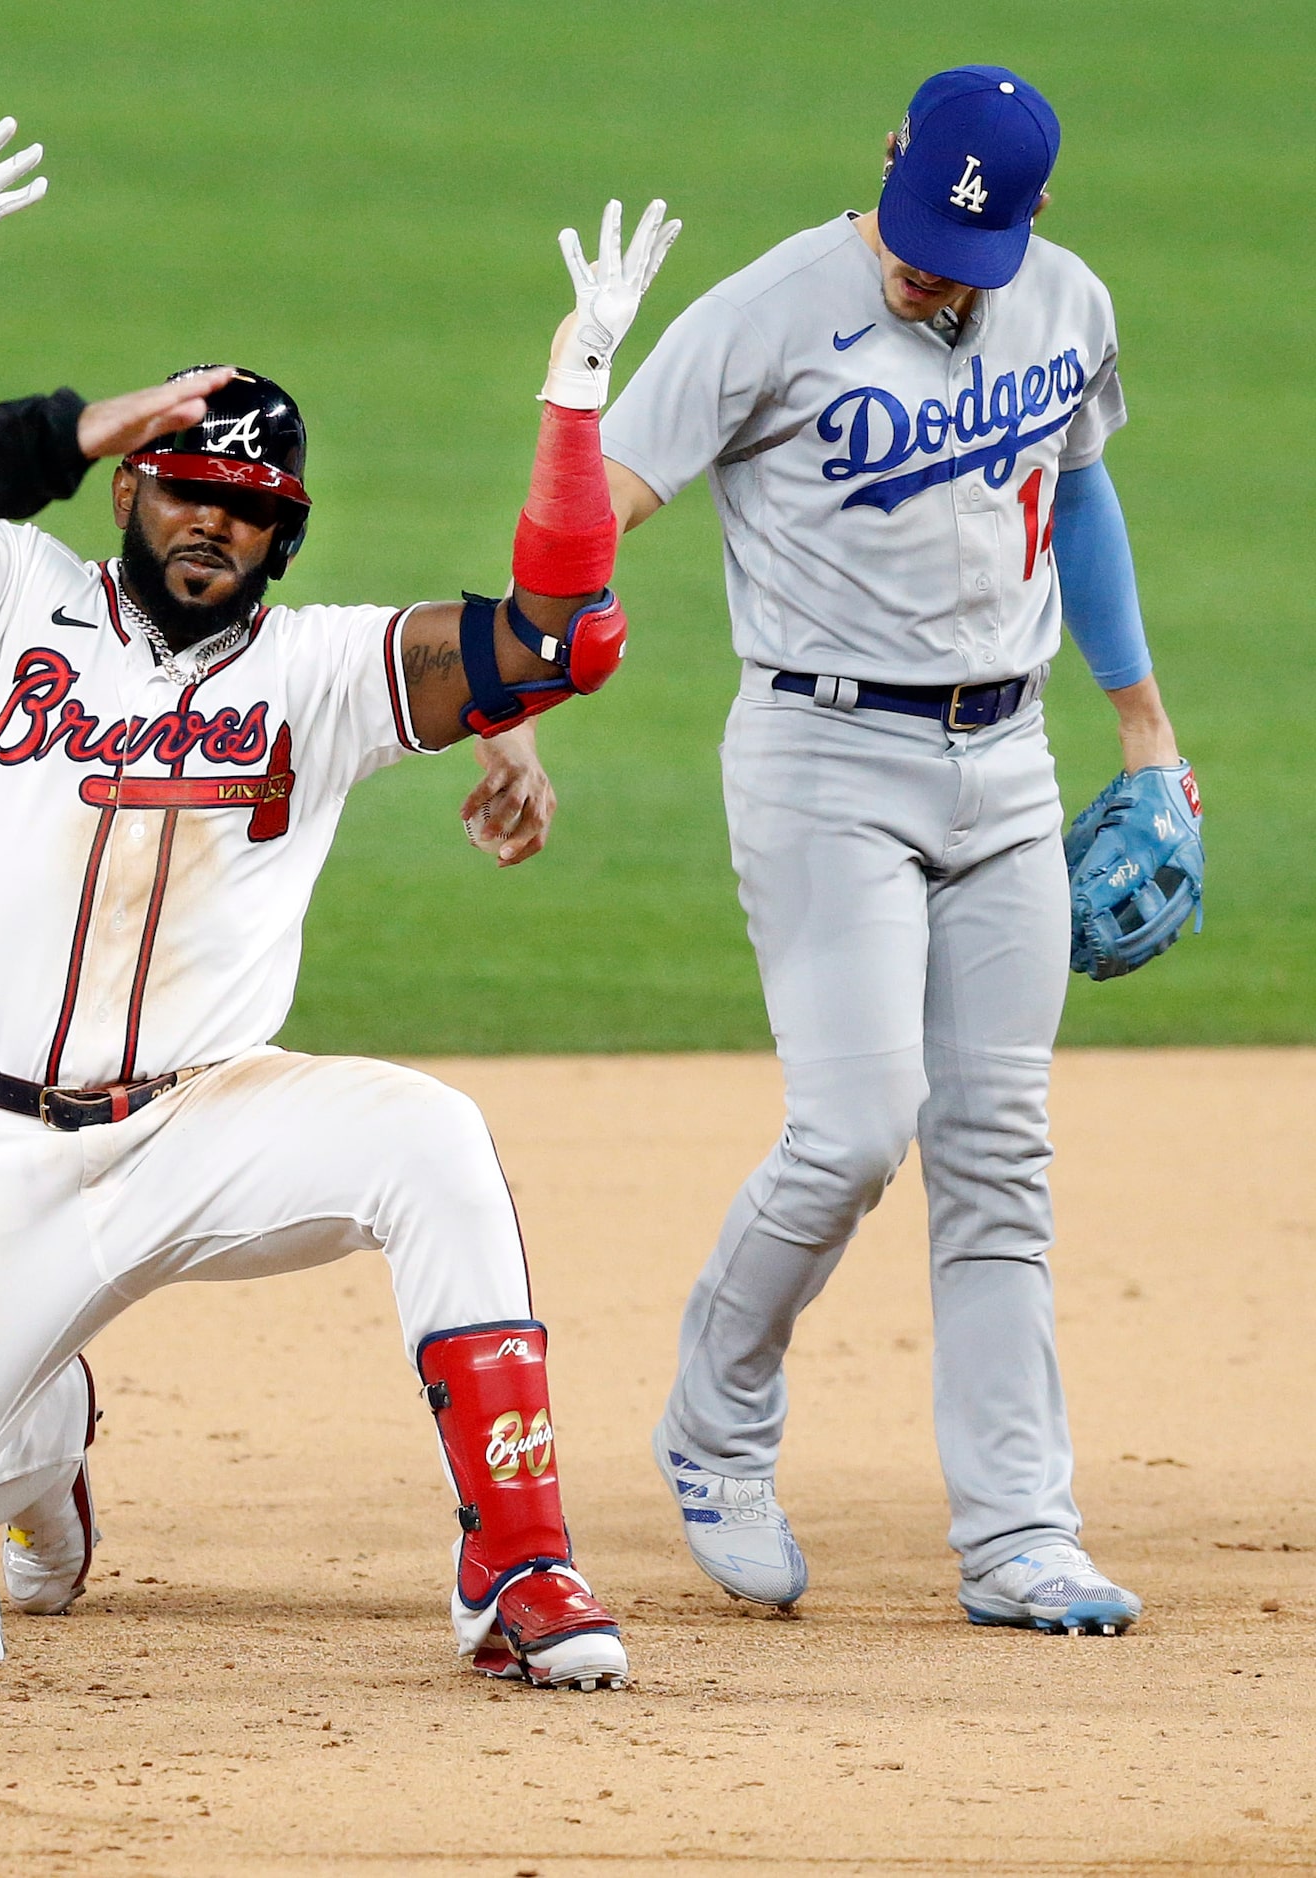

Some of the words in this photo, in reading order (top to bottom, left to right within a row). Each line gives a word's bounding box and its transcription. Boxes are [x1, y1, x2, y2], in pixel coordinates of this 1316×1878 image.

[950, 155, 988, 214] LA
[206, 409, 262, 459] A
[816, 348, 1085, 490] Dodgers
